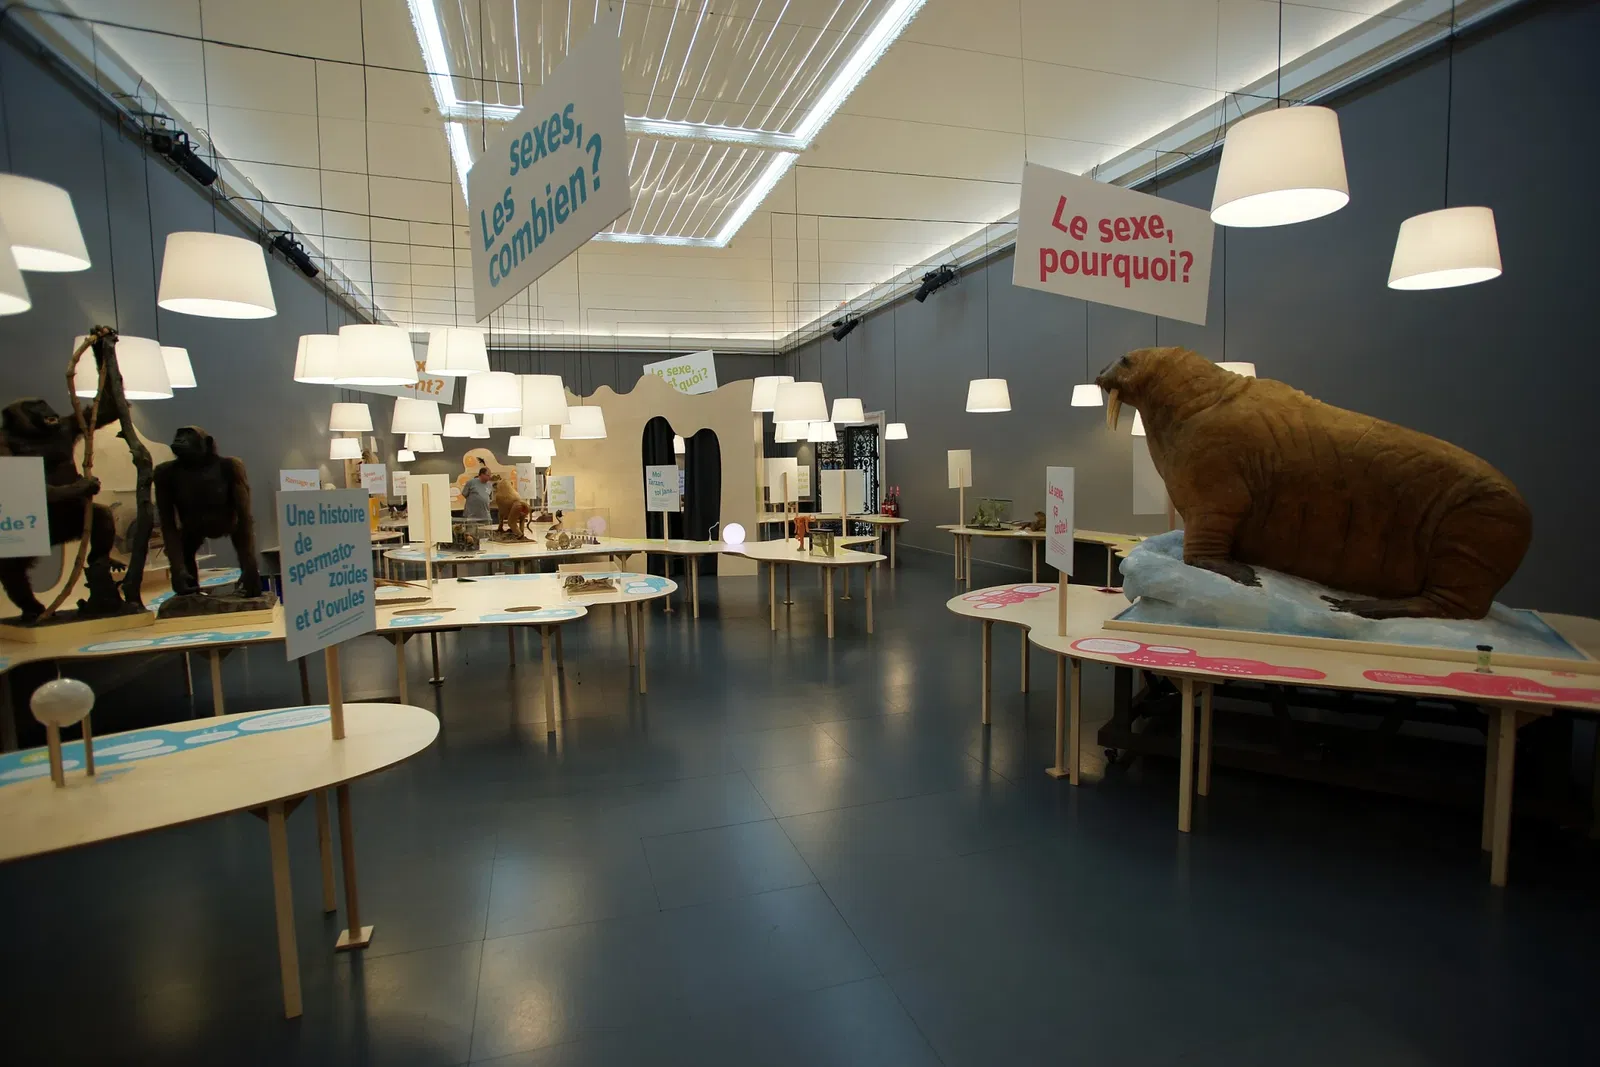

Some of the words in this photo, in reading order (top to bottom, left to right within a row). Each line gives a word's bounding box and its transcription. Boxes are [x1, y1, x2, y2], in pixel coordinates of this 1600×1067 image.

[480, 186, 515, 252] Les
[509, 102, 583, 176] sexes,
[1051, 195, 1088, 240] Le
[1098, 214, 1173, 243] sexe,
[1039, 247, 1194, 288] pourquoi?
[666, 365, 695, 377] sexe,
[679, 367, 708, 391] quoi?
[286, 503, 316, 527] Une
[319, 503, 365, 525] histoire
[294, 532, 313, 556] de
[288, 543, 355, 586] spermato-
[328, 563, 368, 588] zoïdes
[295, 609, 312, 632] et
[313, 588, 366, 625] d'ovules
